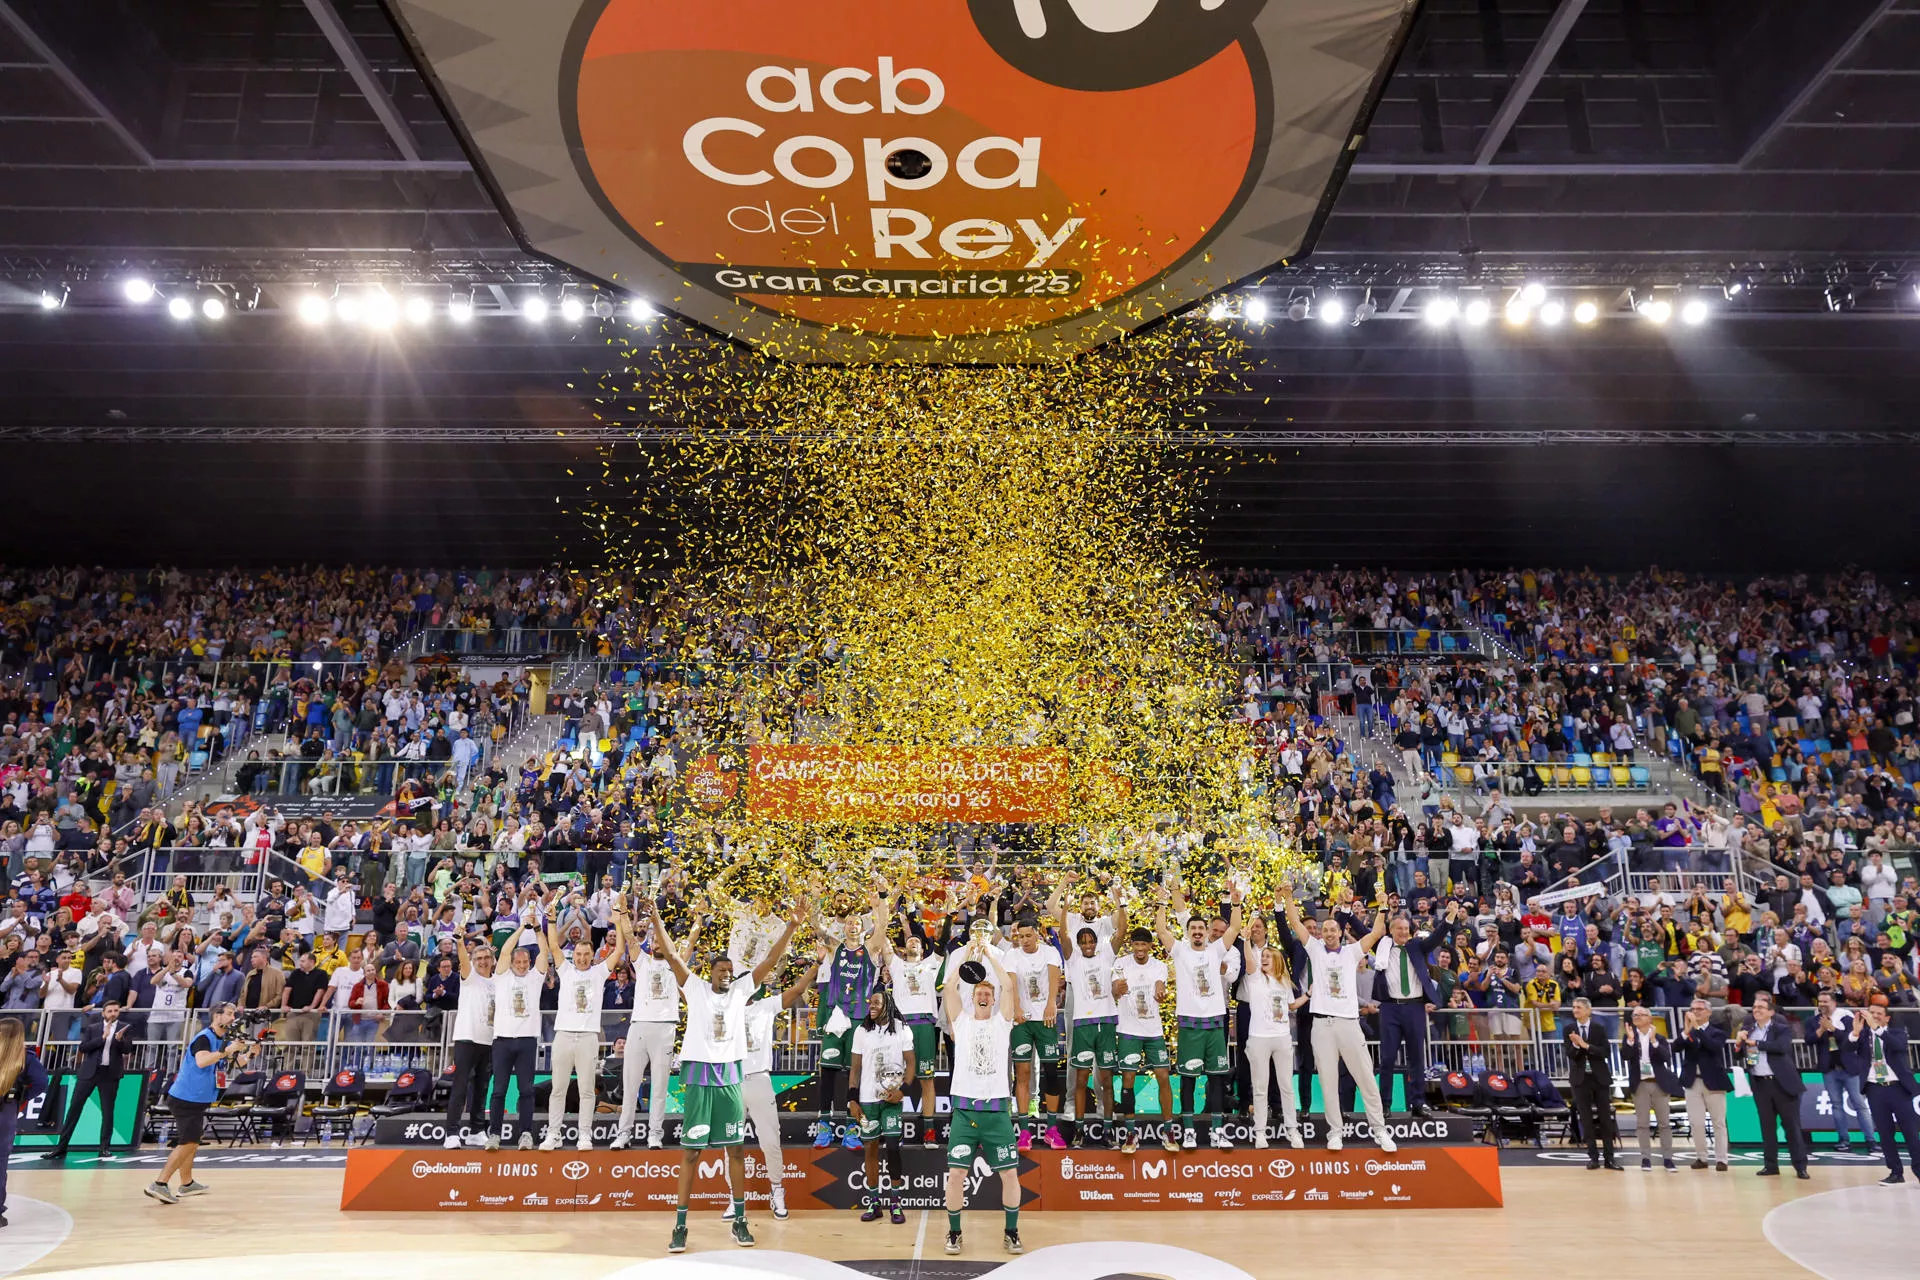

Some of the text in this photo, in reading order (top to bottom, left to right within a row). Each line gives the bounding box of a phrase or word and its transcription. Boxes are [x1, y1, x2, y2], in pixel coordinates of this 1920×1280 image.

[746, 56, 945, 115] acb
[683, 117, 1042, 201] Copa
[727, 200, 1086, 268] del Rey
[715, 269, 821, 293] Gran
[835, 274, 1007, 295] Canaria
[165, 994, 173, 1006] 9
[1497, 994, 1504, 1004] 2
[415, 1162, 481, 1175] mediolanum
[497, 1163, 538, 1177] IONOS
[1075, 1164, 1115, 1172] Cabildo de
[1182, 1160, 1253, 1178] endesa
[1310, 1161, 1350, 1175] IONOS
[1367, 1160, 1426, 1172] mediolanum
[914, 1175, 938, 1188] del
[1075, 1171, 1124, 1180] Gran Canaria
[608, 1190, 634, 1200] renfe
[1080, 1190, 1114, 1200] Wilson
[1214, 1188, 1241, 1199] renfe
